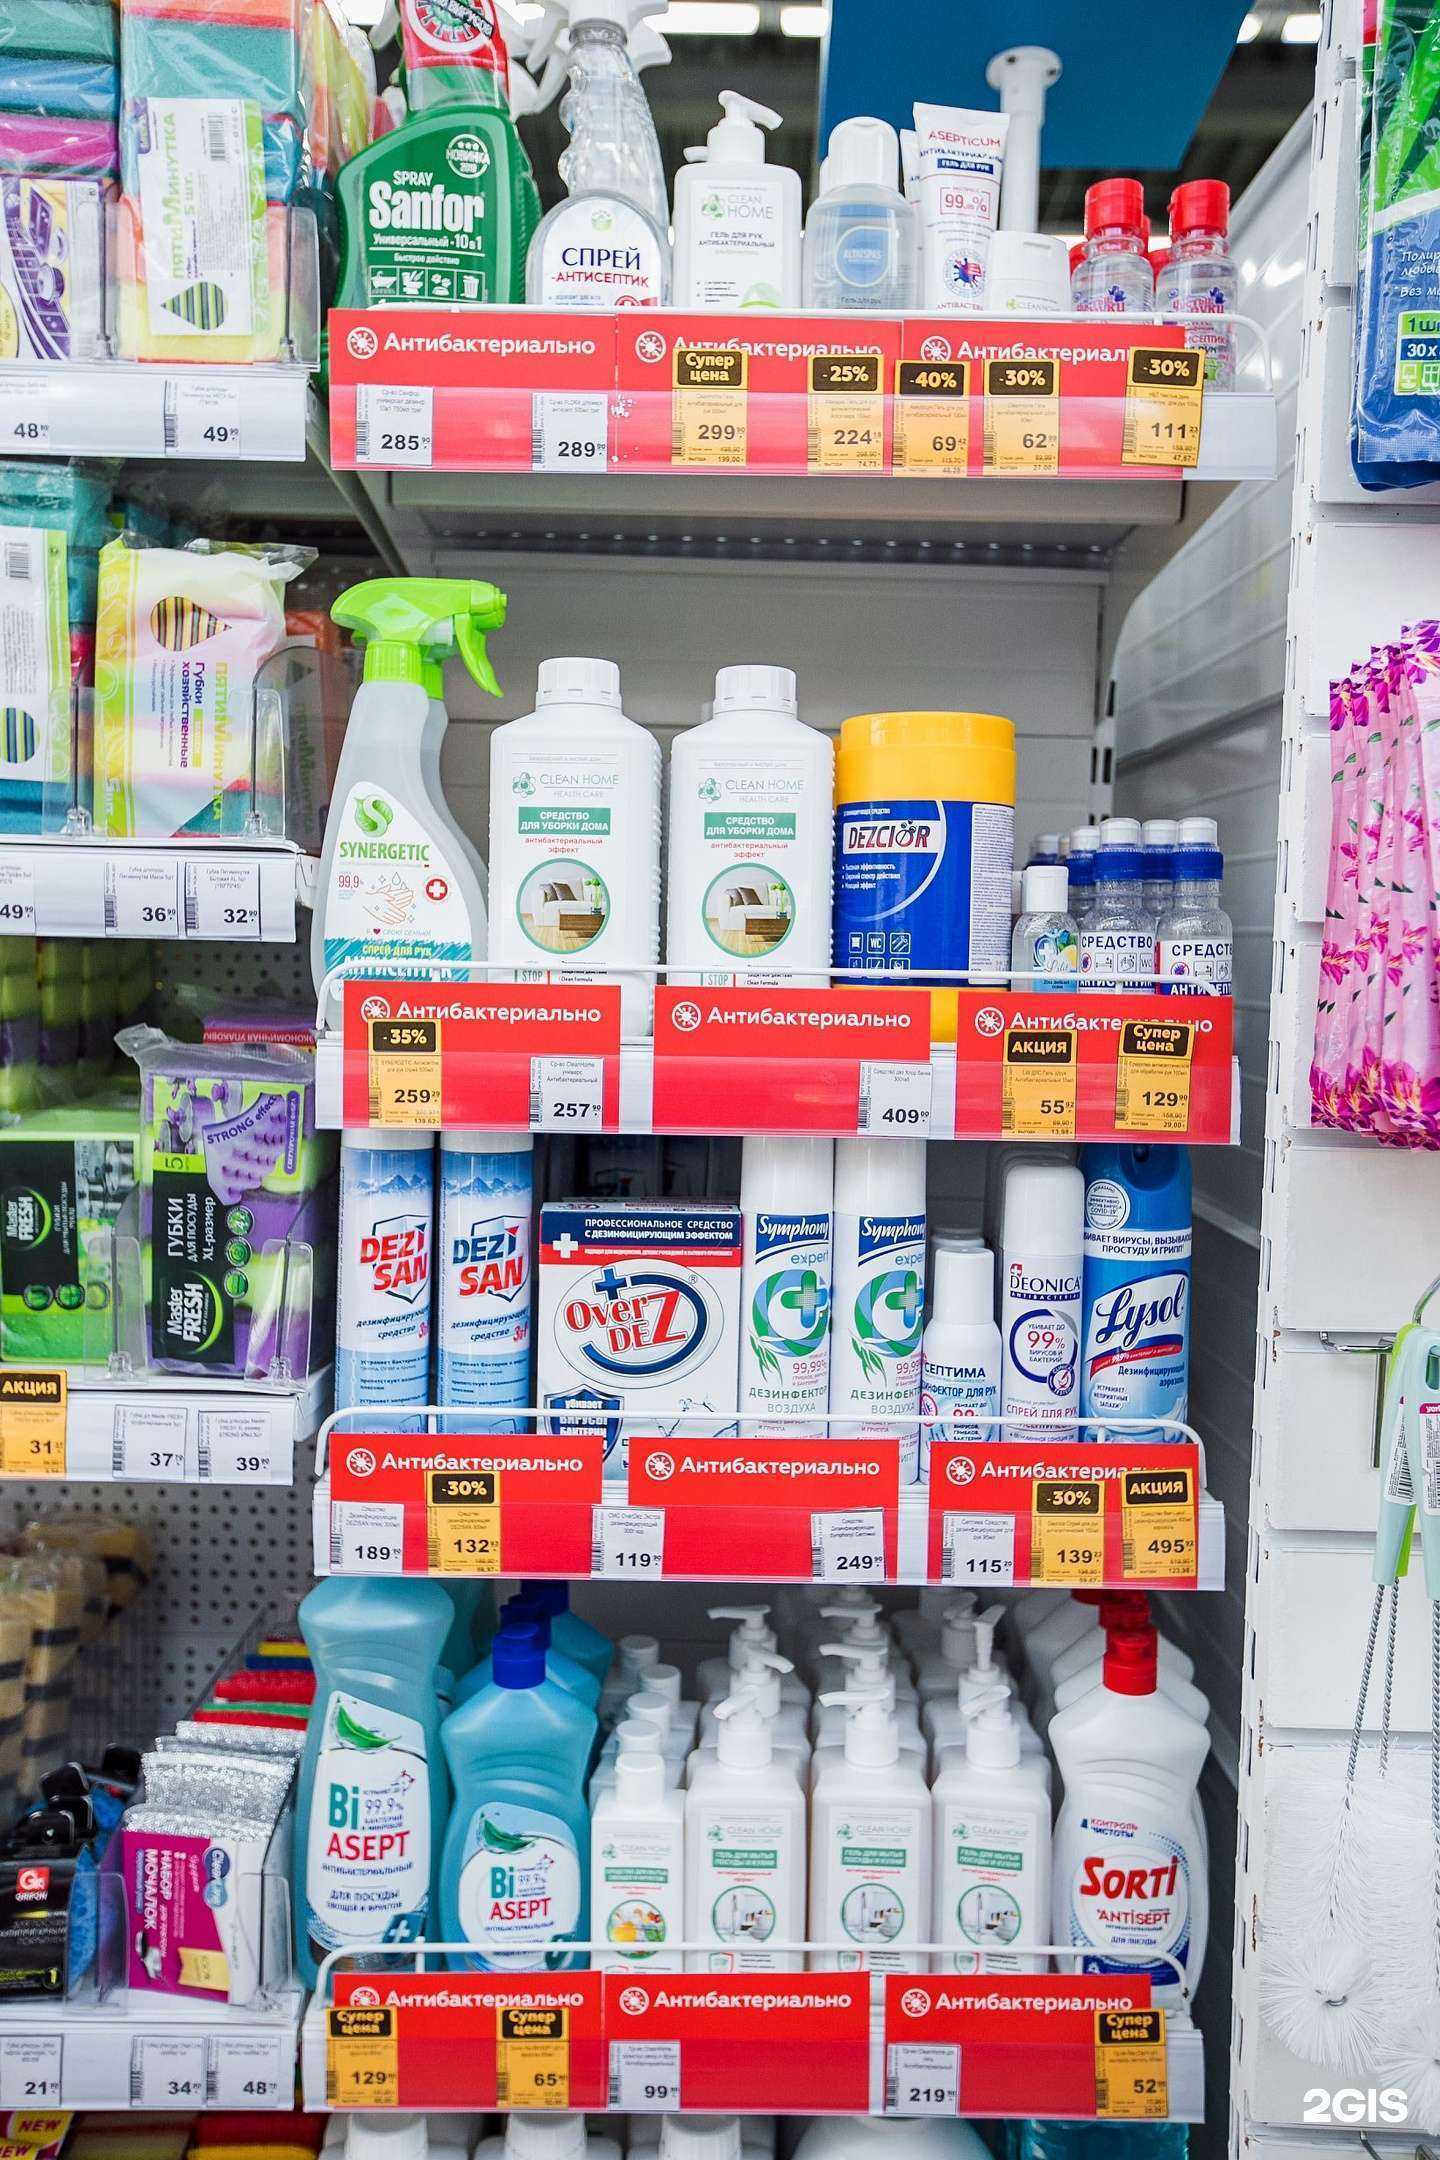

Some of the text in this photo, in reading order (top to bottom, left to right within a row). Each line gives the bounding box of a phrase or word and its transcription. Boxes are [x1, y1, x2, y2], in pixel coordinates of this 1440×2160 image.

[393, 171, 433, 186] SPRAY
[369, 181, 484, 233] Sanfor
[561, 247, 641, 271] СПРЕЙ
[384, 332, 596, 358] Антибактериально
[685, 352, 734, 368] Супер
[690, 369, 730, 382] цена
[822, 365, 869, 382] -25%
[1143, 358, 1190, 378] -30%
[909, 371, 957, 388] -40%
[999, 368, 1045, 387] -30%
[13, 423, 40, 438] 48
[203, 426, 229, 442] 49
[698, 424, 736, 440] 299
[833, 429, 872, 445] 224
[1150, 422, 1187, 439] 111
[381, 434, 420, 450] 285
[932, 436, 956, 451] 69
[1022, 433, 1047, 449] 62
[558, 441, 596, 457] 289
[540, 774, 619, 785] CLEAN HOME
[725, 778, 804, 791] CLEAN HOME
[540, 812, 589, 820] СРЕДСТВО
[725, 816, 775, 825] СРЕДСТВО
[521, 822, 608, 831] ДЛЯ УБОРКИ ДОМА
[706, 826, 794, 836] ДЛЯ УБОРКИ ДОМА
[339, 841, 430, 861] SYNERGETIC
[142, 907, 166, 922] 36
[223, 909, 248, 923] 32
[870, 938, 882, 949] WC
[1081, 936, 1152, 949] СРЕДСТВО
[522, 970, 543, 982] STOP
[708, 974, 729, 985] STOP
[396, 1001, 602, 1024] Антибактериально
[706, 1007, 911, 1029] Антибактериально
[383, 1028, 427, 1045] -35%
[1133, 1024, 1181, 1041] Супер
[1012, 1039, 1067, 1055] АКЦИЯ
[1136, 1040, 1174, 1053] цена
[393, 1089, 431, 1104] 259
[1142, 1092, 1178, 1107] 129
[553, 1103, 590, 1117] 257
[1040, 1100, 1065, 1115] 55
[882, 1108, 919, 1124] 409
[207, 1117, 254, 1145] STRONG
[165, 1158, 183, 1169] 5
[18, 1197, 33, 1241] FRESH
[585, 1218, 733, 1229] ПРОФЕССИОНАЛЬНОЕ СРЕДСТВО
[168, 1198, 184, 1257] ГУБКИ
[186, 1193, 198, 1262] ДЛЯ ПОСУДЫ
[584, 1230, 733, 1240] С ДЕЗИНФИЦИРУЮЩИМ ЭФФЕКТОМ
[758, 1216, 828, 1241] Symphony
[360, 1223, 427, 1264] DEZI
[452, 1225, 520, 1264] DEZI
[1113, 1236, 1153, 1246] ВИРУСЫ,
[1102, 1245, 1150, 1255] ПРОСТУДУ
[1160, 1246, 1184, 1254] ГРИПП
[373, 1253, 428, 1291] SAN
[459, 1256, 524, 1296] SAN
[1010, 1275, 1080, 1292] DEONICA
[167, 1287, 184, 1336] Master
[183, 1283, 204, 1343] FRESH
[564, 1295, 648, 1332] Over
[1095, 1277, 1185, 1348] Lysol
[377, 1326, 416, 1339] средство
[470, 1329, 510, 1341] средство
[1027, 1330, 1065, 1349] 99%
[924, 1362, 986, 1378] СЕПТИМА
[2, 1381, 58, 1395] АКЦИЯ
[966, 1385, 996, 1398] ДЛЯ РУК
[768, 1402, 815, 1413] ВОЗДУХА
[872, 1403, 914, 1414] ВОЗДУХА
[1006, 1405, 1077, 1418] СПРЕЙ ДЛЯ РУК
[30, 1440, 52, 1454] 31
[150, 1452, 173, 1467] 37
[236, 1457, 260, 1471] 39
[381, 1452, 583, 1472] Антибактериально
[680, 1456, 880, 1478] Антибактериально
[442, 1480, 488, 1496] -30%
[1130, 1481, 1184, 1496] АКЦИЯ
[1046, 1490, 1091, 1506] -30%
[354, 1546, 390, 1560] 189
[453, 1539, 490, 1553] 132
[1147, 1540, 1185, 1553] 495
[615, 1553, 651, 1567] 119
[836, 1556, 873, 1570] 249
[1056, 1550, 1093, 1564] 139
[966, 1559, 1002, 1573] 115
[328, 1782, 360, 1831] Bi
[326, 1830, 411, 1861] ASEPT
[144, 1848, 157, 1929] МОЧАЛОК
[491, 1866, 515, 1898] Bi
[490, 1897, 552, 1920] ASEPT
[385, 1990, 584, 2009] Антибактериально
[653, 1991, 852, 2012] Антибактериально
[935, 1992, 1132, 2014] Антибактериально
[336, 2011, 385, 2023] Супер
[508, 2011, 556, 2023] Супер
[1106, 2014, 1153, 2028] Супер
[341, 2024, 380, 2035] цена
[513, 2024, 551, 2035] цена
[1111, 2028, 1149, 2040] цена
[351, 2072, 387, 2085] 129
[533, 2073, 558, 2087] 65
[25, 2082, 48, 2095] 21
[168, 2082, 192, 2095] 34
[243, 2081, 267, 2095] 48
[644, 2085, 668, 2099] 99
[1134, 2079, 1157, 2094] 52
[909, 2088, 945, 2102] 219
[19, 2120, 62, 2132] NEW
